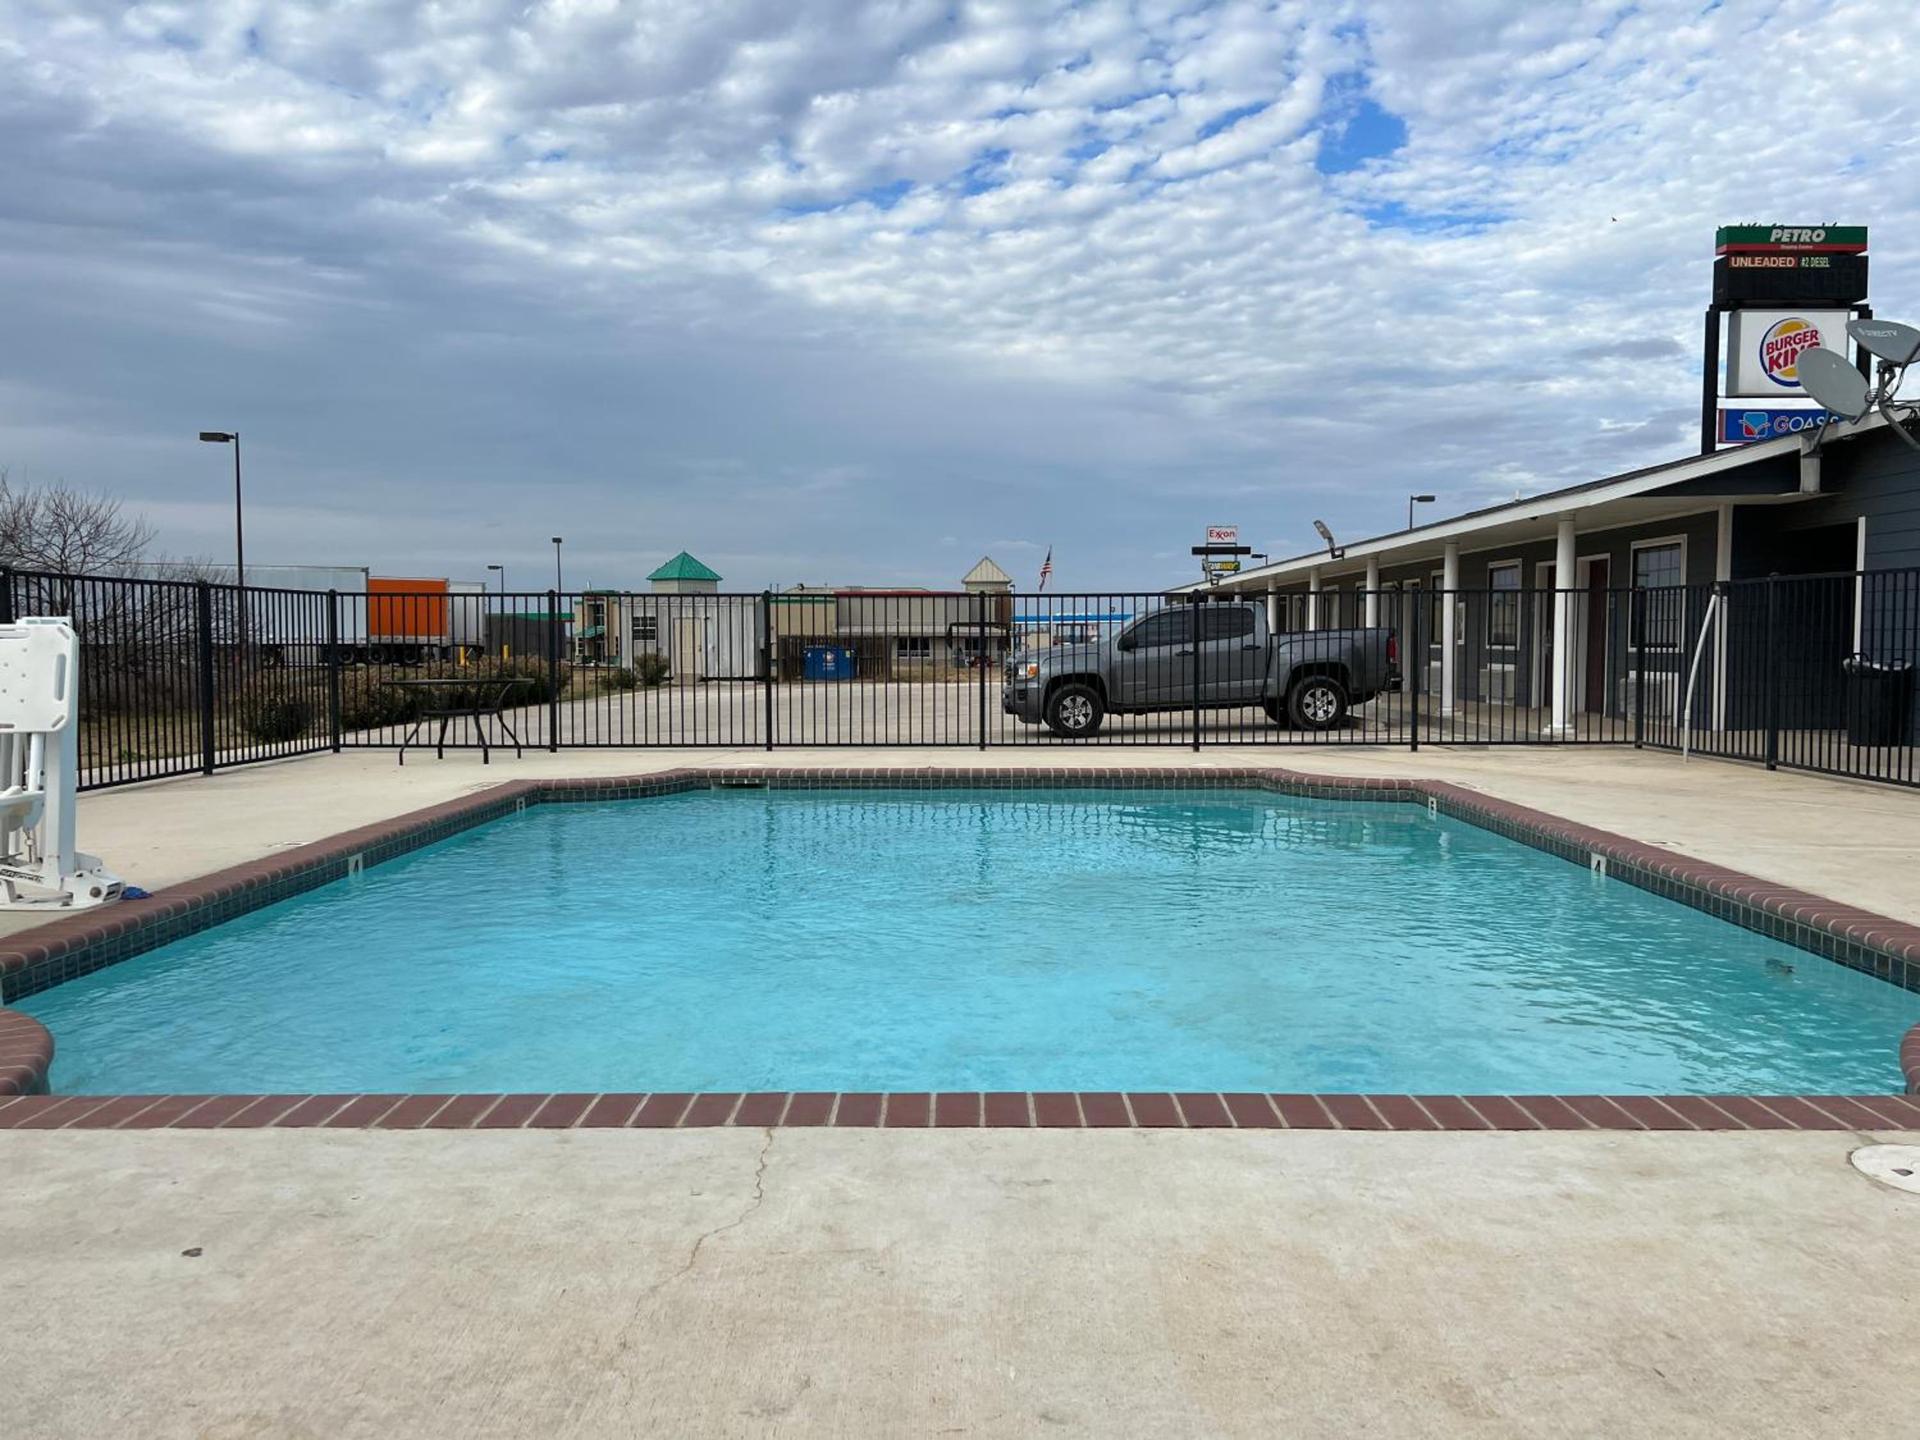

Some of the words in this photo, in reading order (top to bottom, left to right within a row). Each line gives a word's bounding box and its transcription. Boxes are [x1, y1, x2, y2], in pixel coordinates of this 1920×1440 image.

[1770, 228, 1826, 243] PETRO
[1731, 256, 1795, 268] UNLEADED
[1766, 329, 1819, 356] BURGER
[1209, 529, 1235, 540] Exxon
